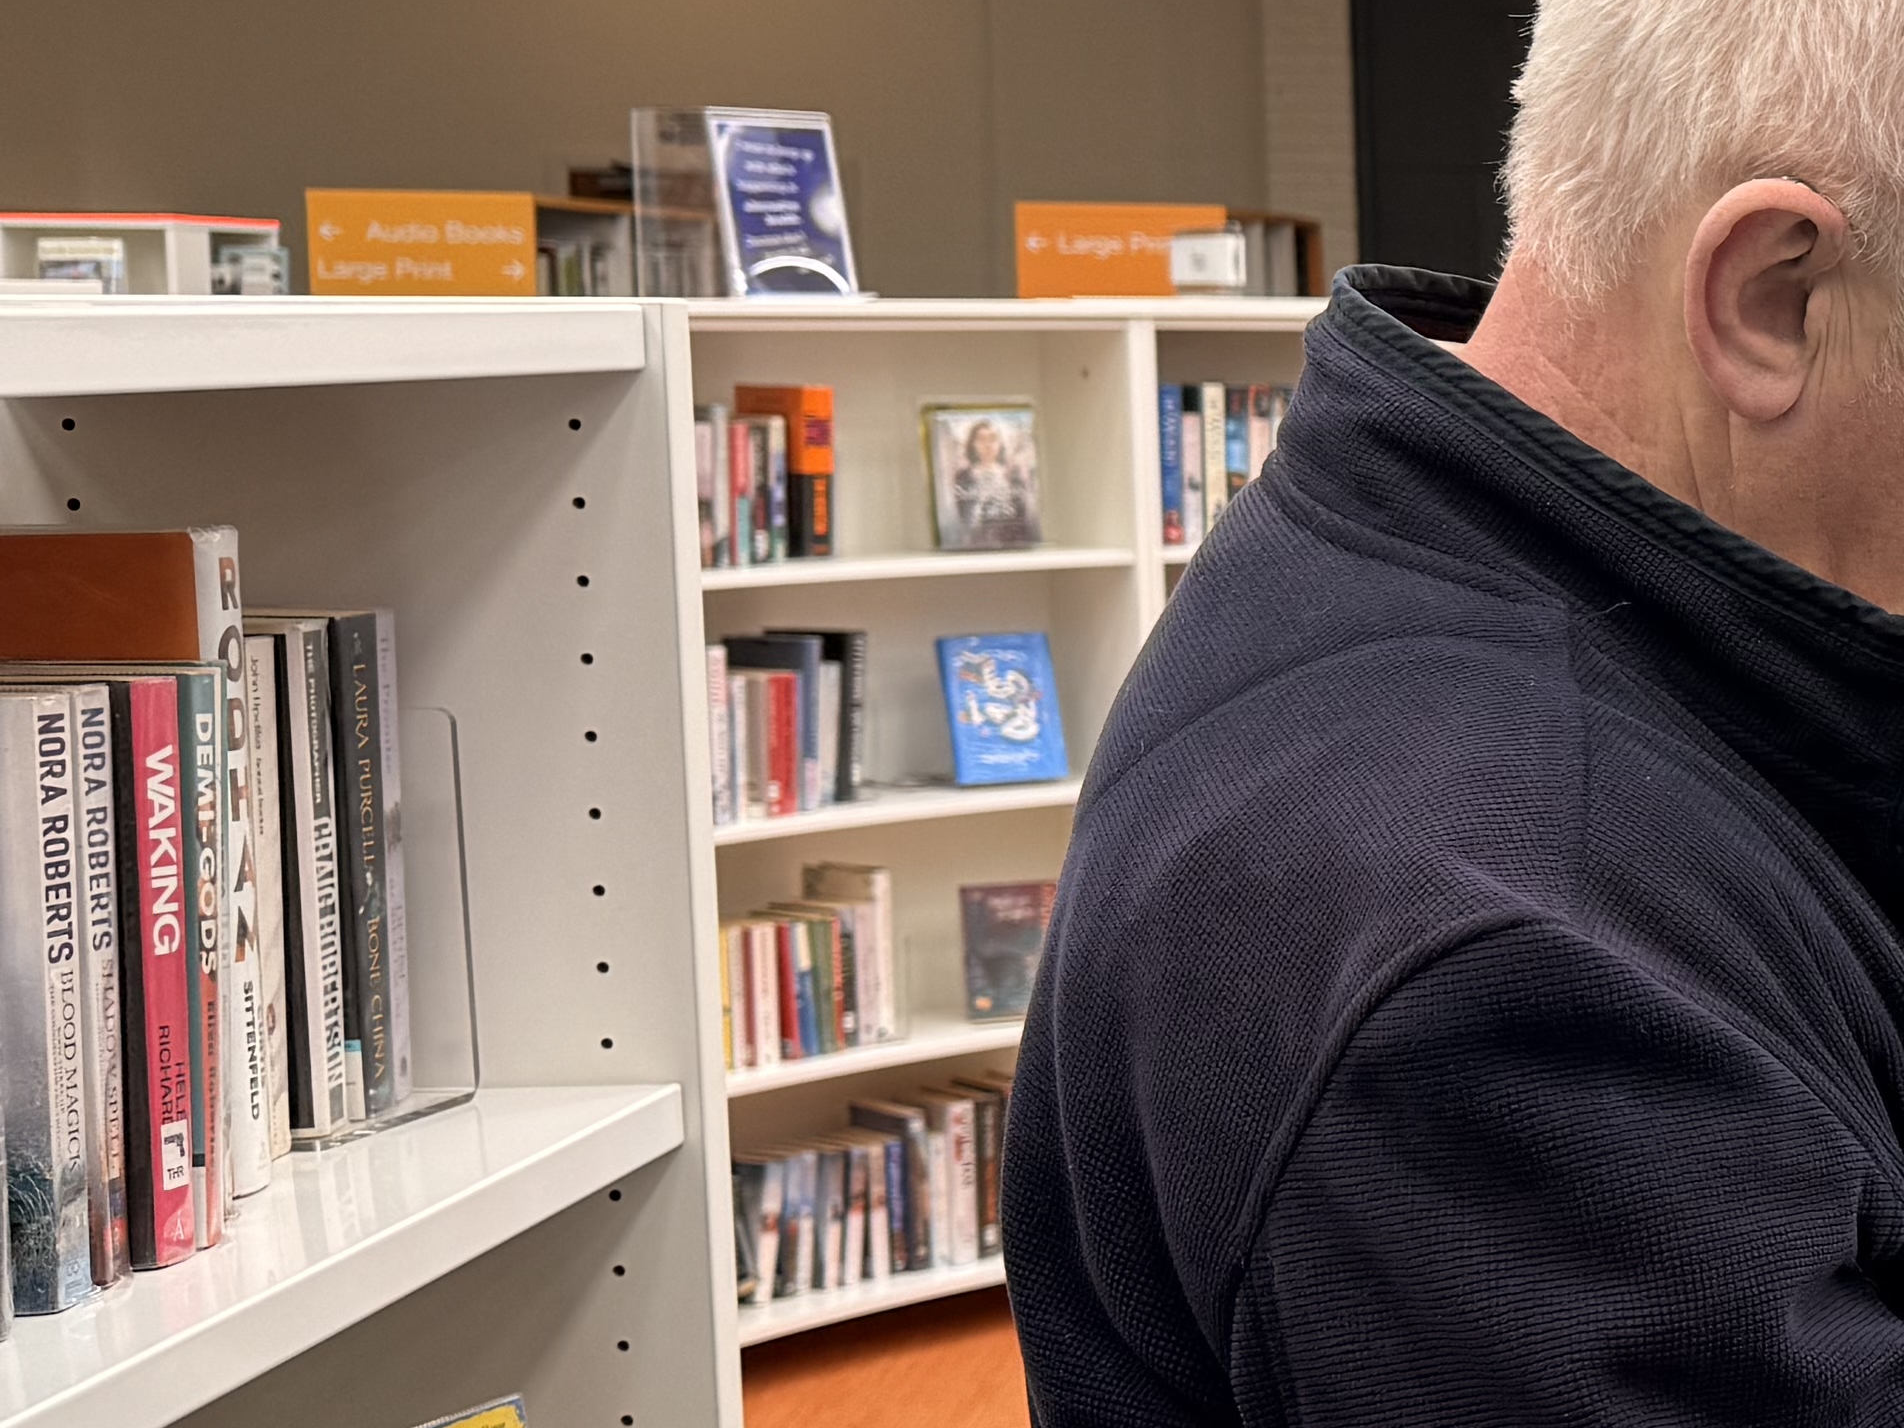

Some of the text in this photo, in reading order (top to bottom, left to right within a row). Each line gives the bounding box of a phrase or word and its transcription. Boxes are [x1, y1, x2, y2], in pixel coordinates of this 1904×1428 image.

[318, 257, 453, 284] Large Print
[367, 221, 526, 246] Audio Books
[35, 712, 86, 1175] NORA ROBERTS BLOOD MAGICK
[79, 705, 114, 953] NORA ROBERTS
[142, 742, 181, 959] WAKING
[195, 712, 215, 975] DEMI-GODS
[352, 663, 388, 1083] LAURA PURCELL BONE CHINA
[242, 979, 260, 1120] SITTENFELD
